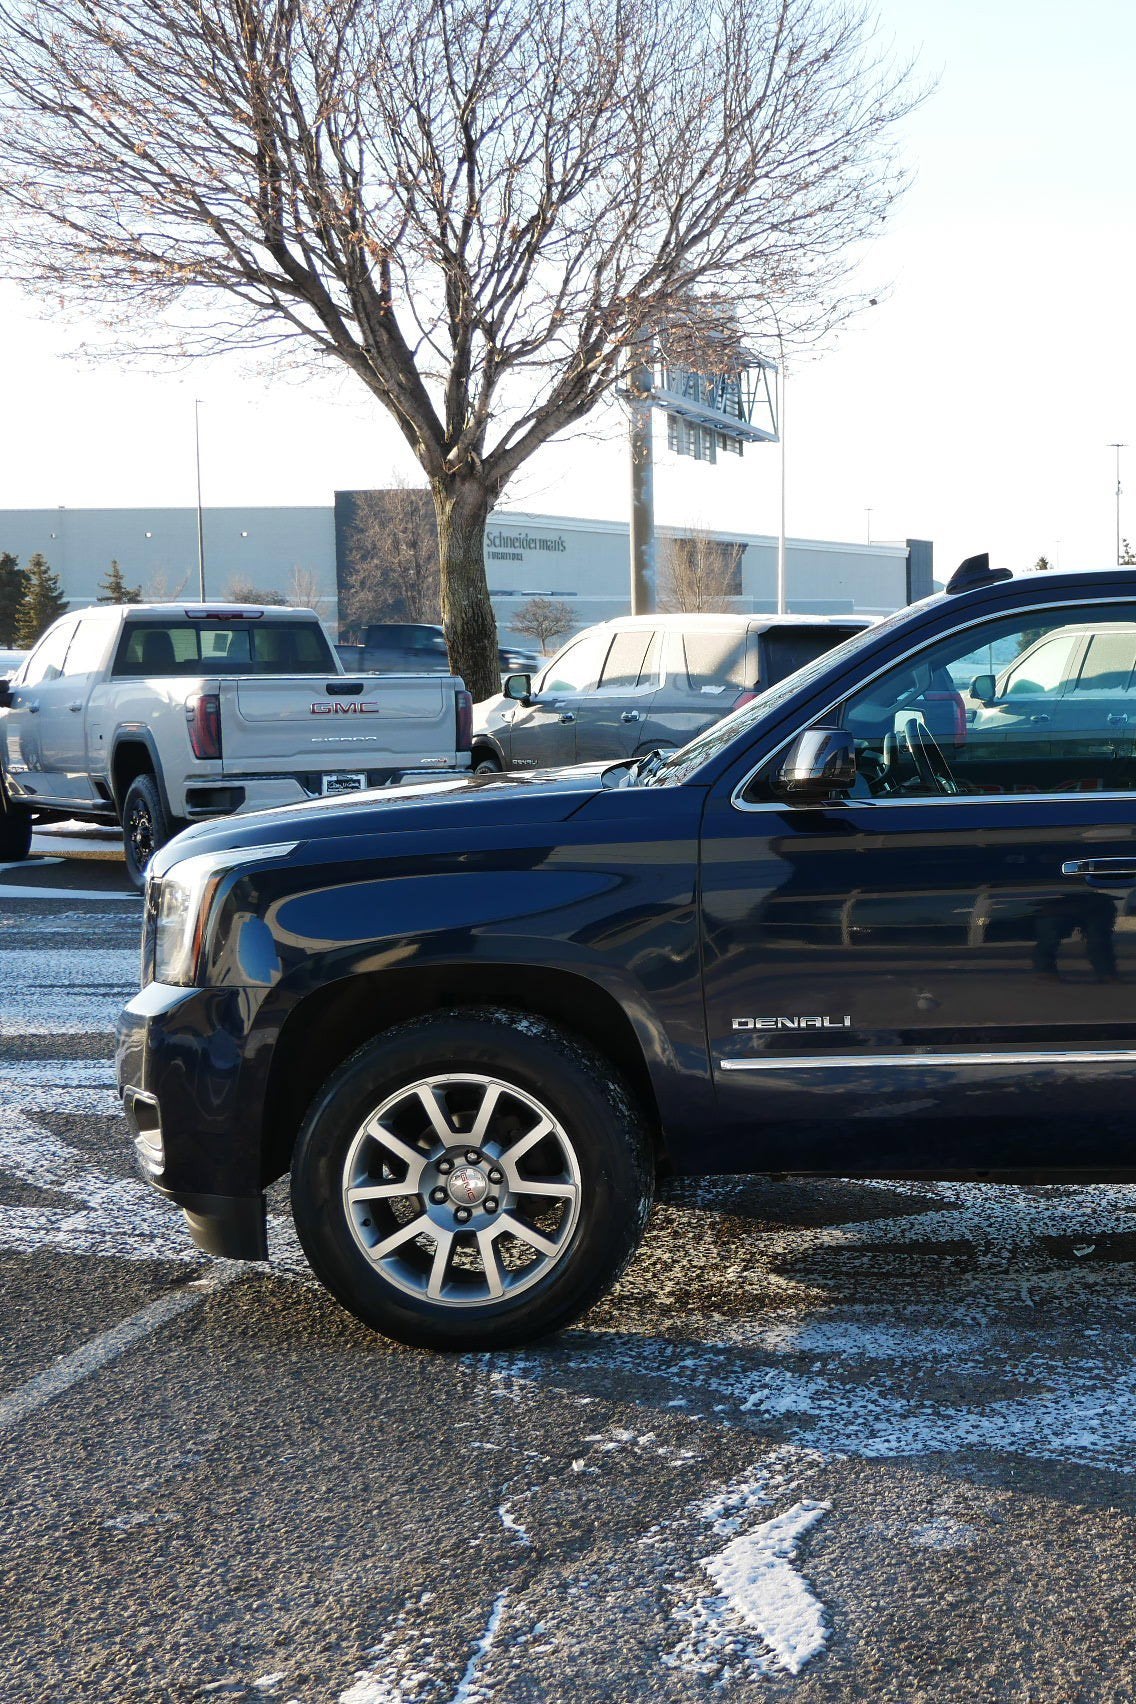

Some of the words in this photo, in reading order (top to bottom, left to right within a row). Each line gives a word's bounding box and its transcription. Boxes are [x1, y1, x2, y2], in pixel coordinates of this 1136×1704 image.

[486, 531, 566, 552] Schneiderman's
[310, 701, 380, 715] GMC
[731, 1015, 851, 1030] DENALI
[460, 1172, 477, 1201] GMC
